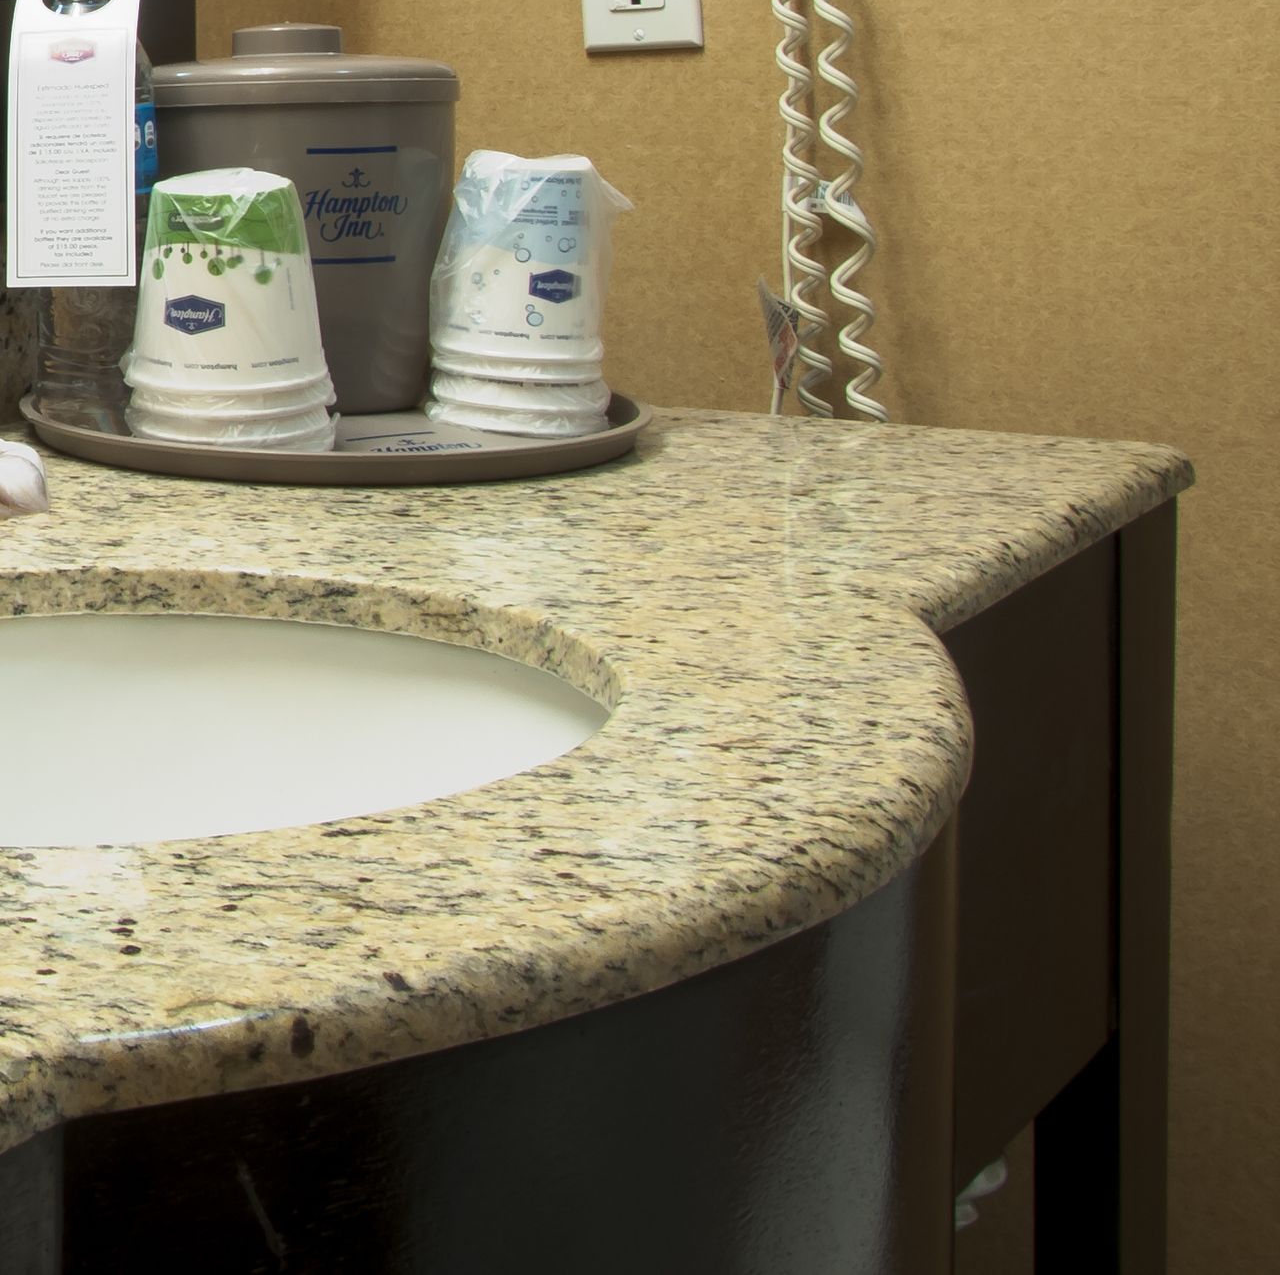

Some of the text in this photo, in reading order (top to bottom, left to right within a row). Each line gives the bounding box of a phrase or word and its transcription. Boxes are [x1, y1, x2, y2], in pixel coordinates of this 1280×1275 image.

[304, 188, 408, 221] Hampton
[320, 214, 382, 242] Inn
[166, 305, 222, 325] Hampton
[184, 363, 238, 372] hampton.com
